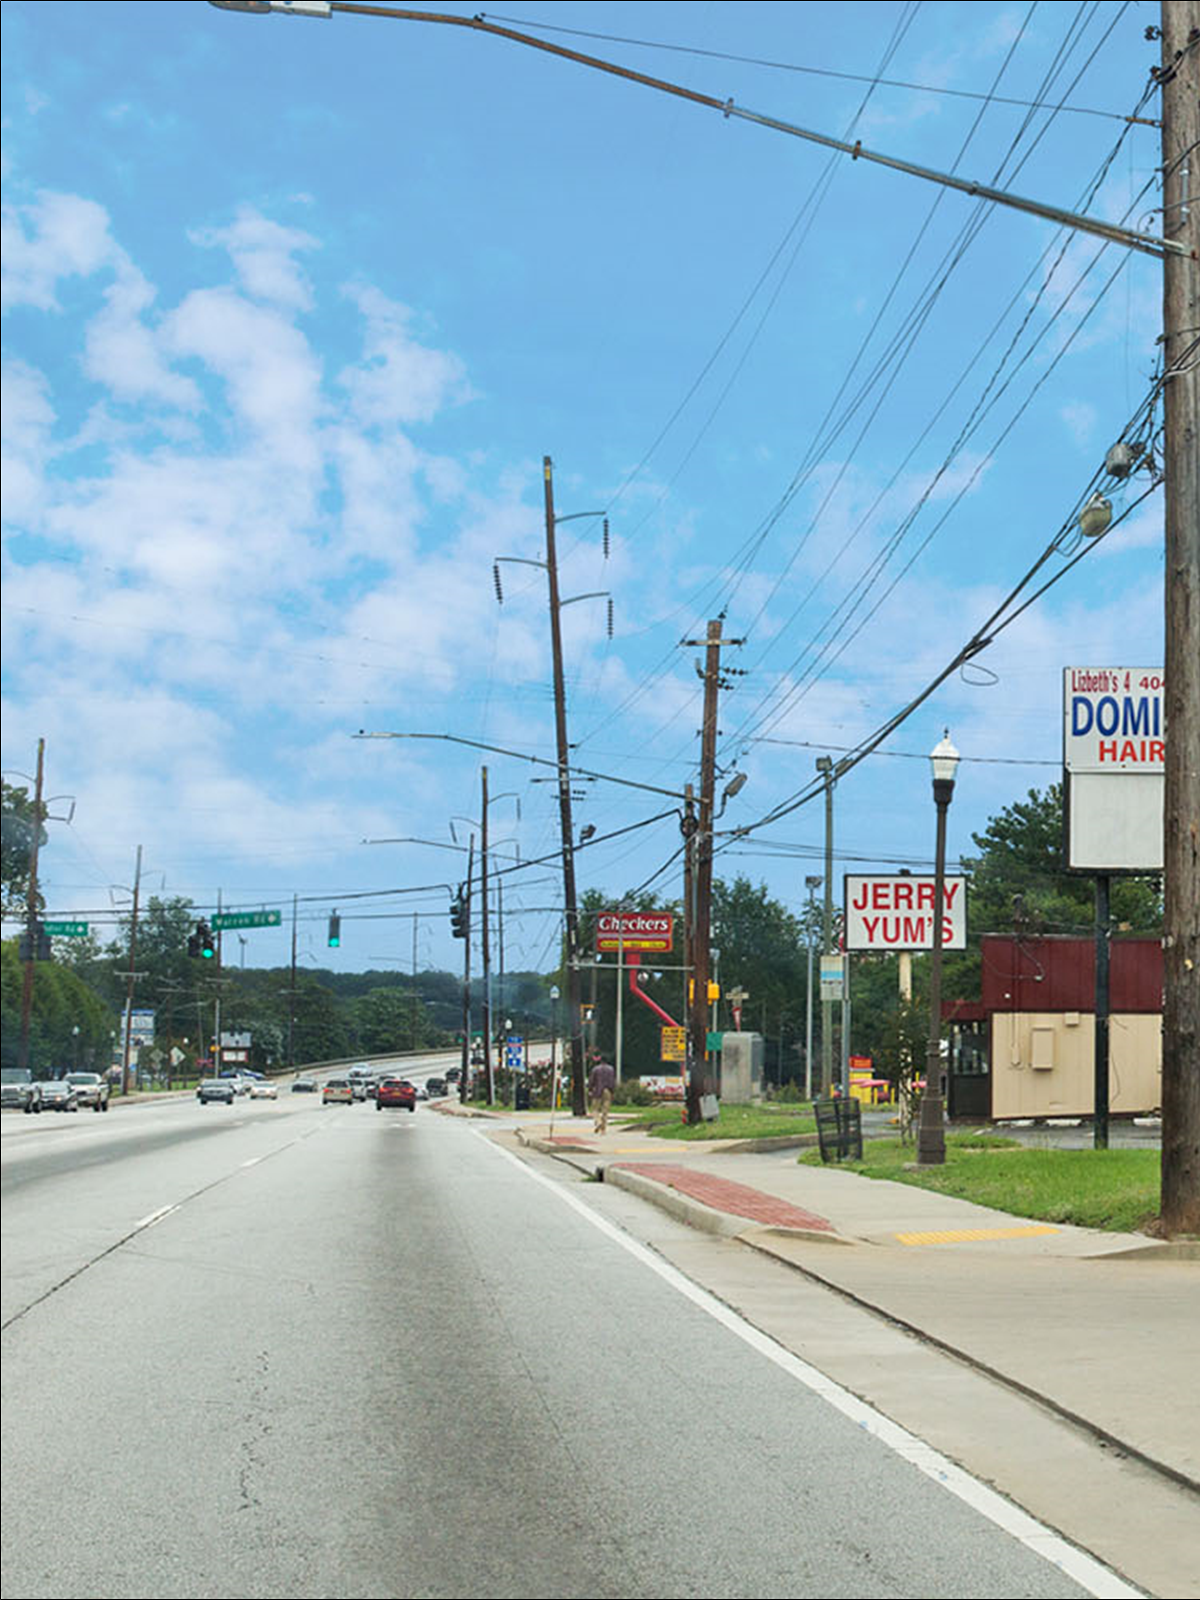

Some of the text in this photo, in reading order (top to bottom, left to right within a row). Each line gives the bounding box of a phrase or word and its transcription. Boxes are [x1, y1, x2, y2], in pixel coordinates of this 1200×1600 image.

[1099, 740, 1165, 762] HAIR
[853, 882, 959, 910] JERRY
[599, 915, 669, 931] Checkers
[862, 916, 954, 943] YUM'S
